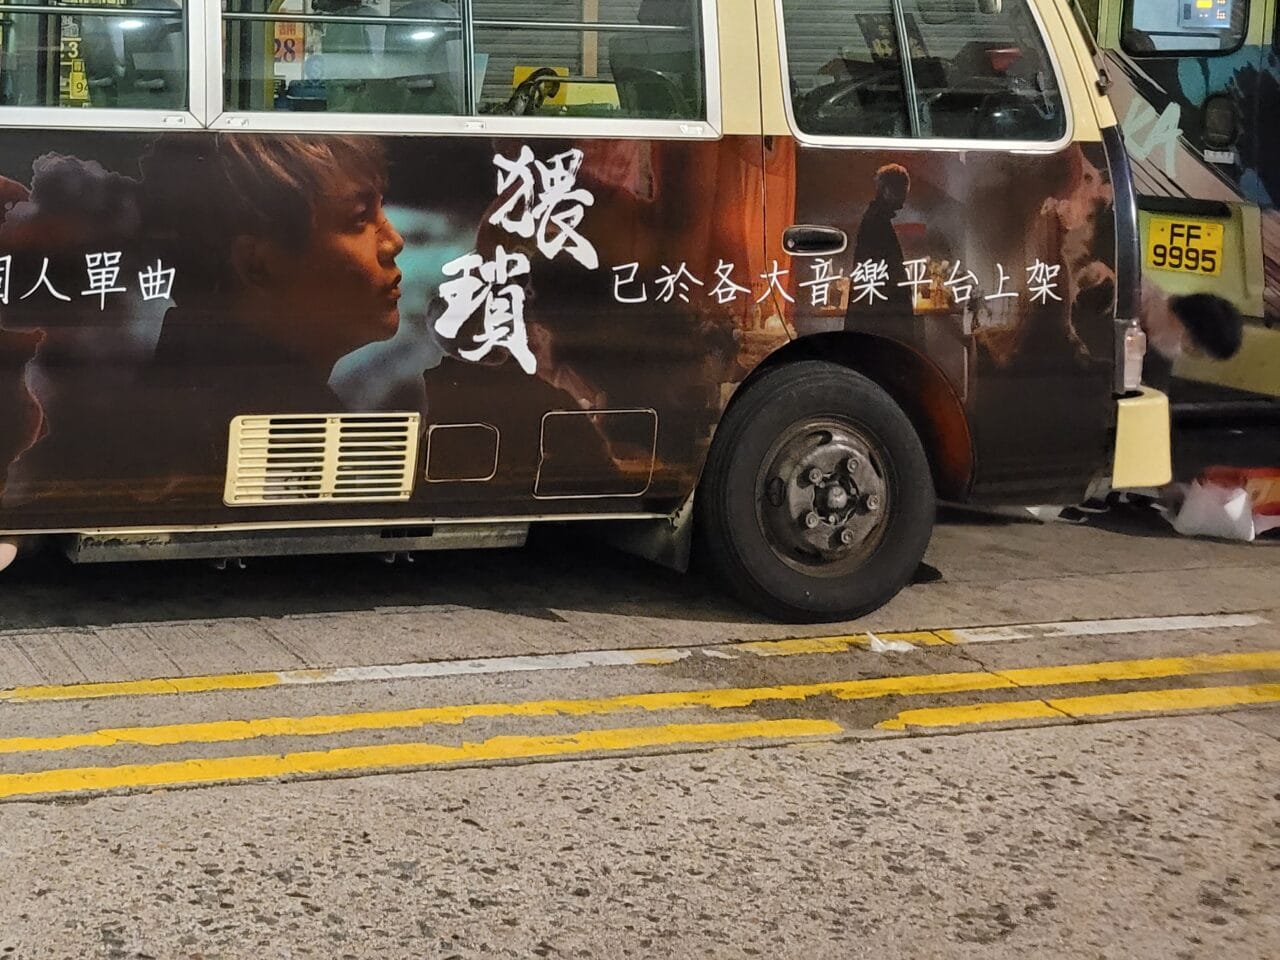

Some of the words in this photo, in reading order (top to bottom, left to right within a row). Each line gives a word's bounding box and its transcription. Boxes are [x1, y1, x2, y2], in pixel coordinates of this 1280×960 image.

[1169, 223, 1202, 248] FF
[1152, 243, 1218, 273] 9995
[610, 255, 1064, 308] 已於各大音樂平台上架
